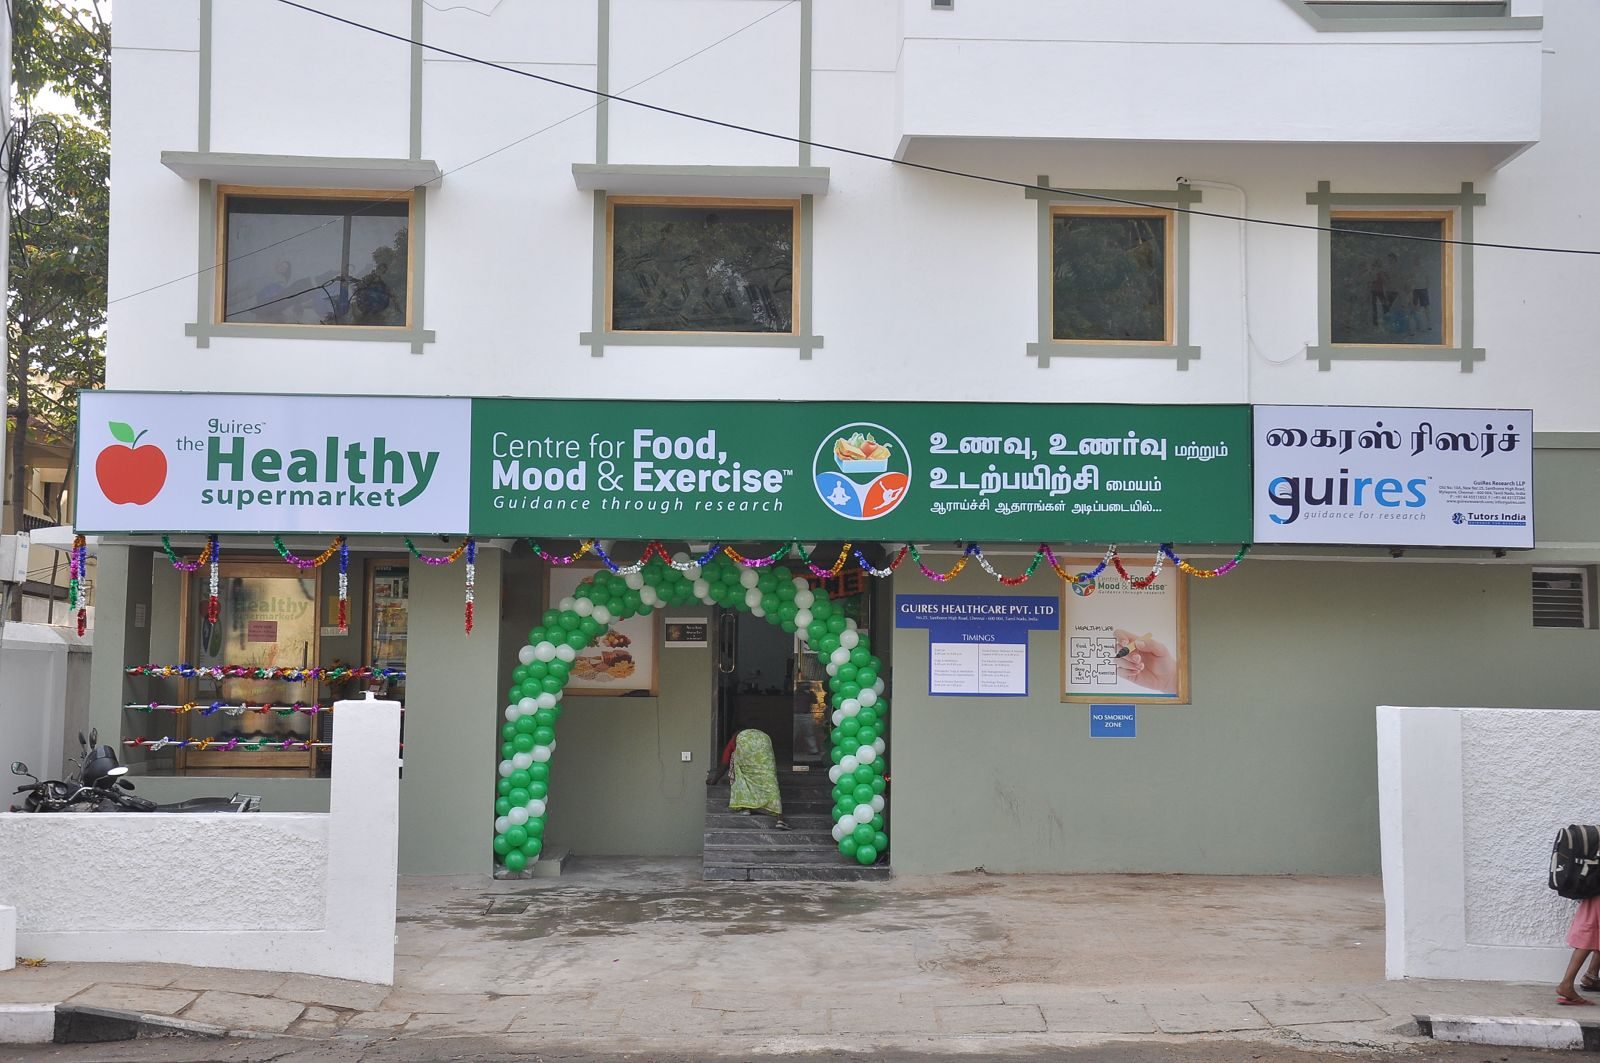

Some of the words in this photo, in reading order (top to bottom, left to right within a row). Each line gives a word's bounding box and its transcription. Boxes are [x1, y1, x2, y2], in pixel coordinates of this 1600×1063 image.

[492, 431, 580, 460] Centre
[589, 432, 625, 460] for
[634, 428, 728, 465] Food,
[929, 432, 1038, 461] உணவு,
[1048, 430, 1166, 460] உணர்வு
[1174, 441, 1228, 461] மற்றும்
[1266, 421, 1401, 454] கைரஸ்
[1410, 422, 1520, 458] ரிஸர்ச்
[176, 436, 204, 452] the
[206, 436, 440, 507] Healthy
[492, 460, 586, 491] Mood
[598, 460, 624, 492] &
[929, 464, 1098, 496] உடற்பயிற்சி
[1106, 476, 1162, 492] மையம்
[201, 486, 396, 510] supermarket
[494, 494, 591, 511] Guidance
[601, 496, 684, 514] through
[695, 498, 783, 512] research
[930, 498, 990, 514] ஆராய்ச்சி
[994, 500, 1066, 516] ஆதாரங்கள்
[1304, 510, 1354, 521] guidance
[1358, 511, 1375, 520] for
[1379, 512, 1426, 521] research
[901, 604, 938, 613] GUIRES
[941, 604, 1007, 614] HEALTHCARE
[1010, 605, 1031, 614] PVT.
[1035, 606, 1054, 615] LTD
